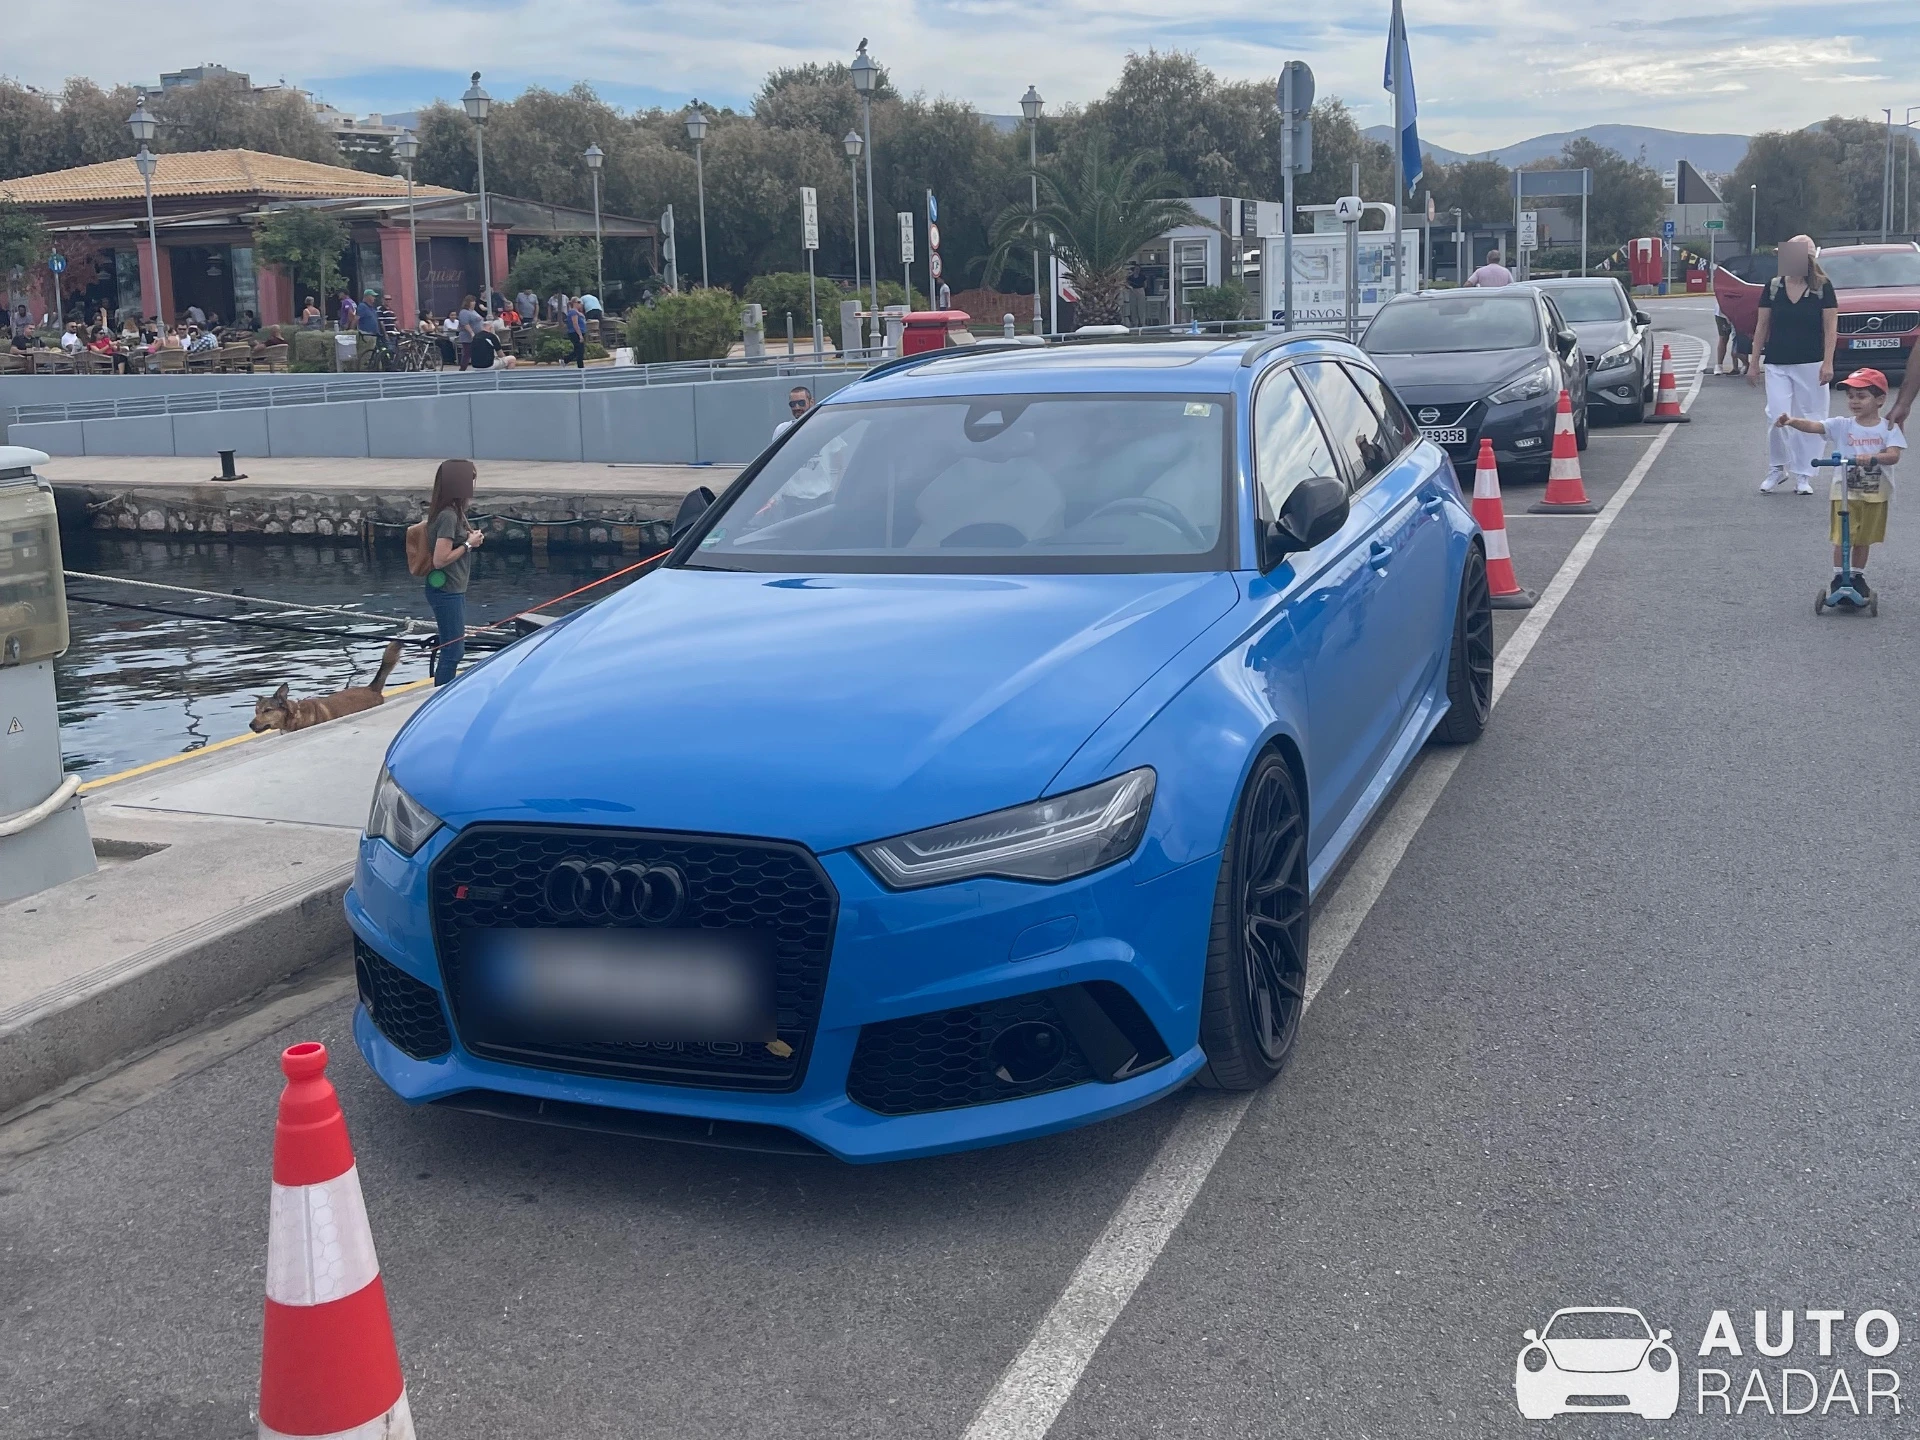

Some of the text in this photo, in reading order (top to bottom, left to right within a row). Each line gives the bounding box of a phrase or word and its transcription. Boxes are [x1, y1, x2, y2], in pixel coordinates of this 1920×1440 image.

[1339, 201, 1349, 214] A
[1357, 201, 1362, 213] A
[1666, 223, 1672, 232] P
[1292, 308, 1343, 319] FLISVOS
